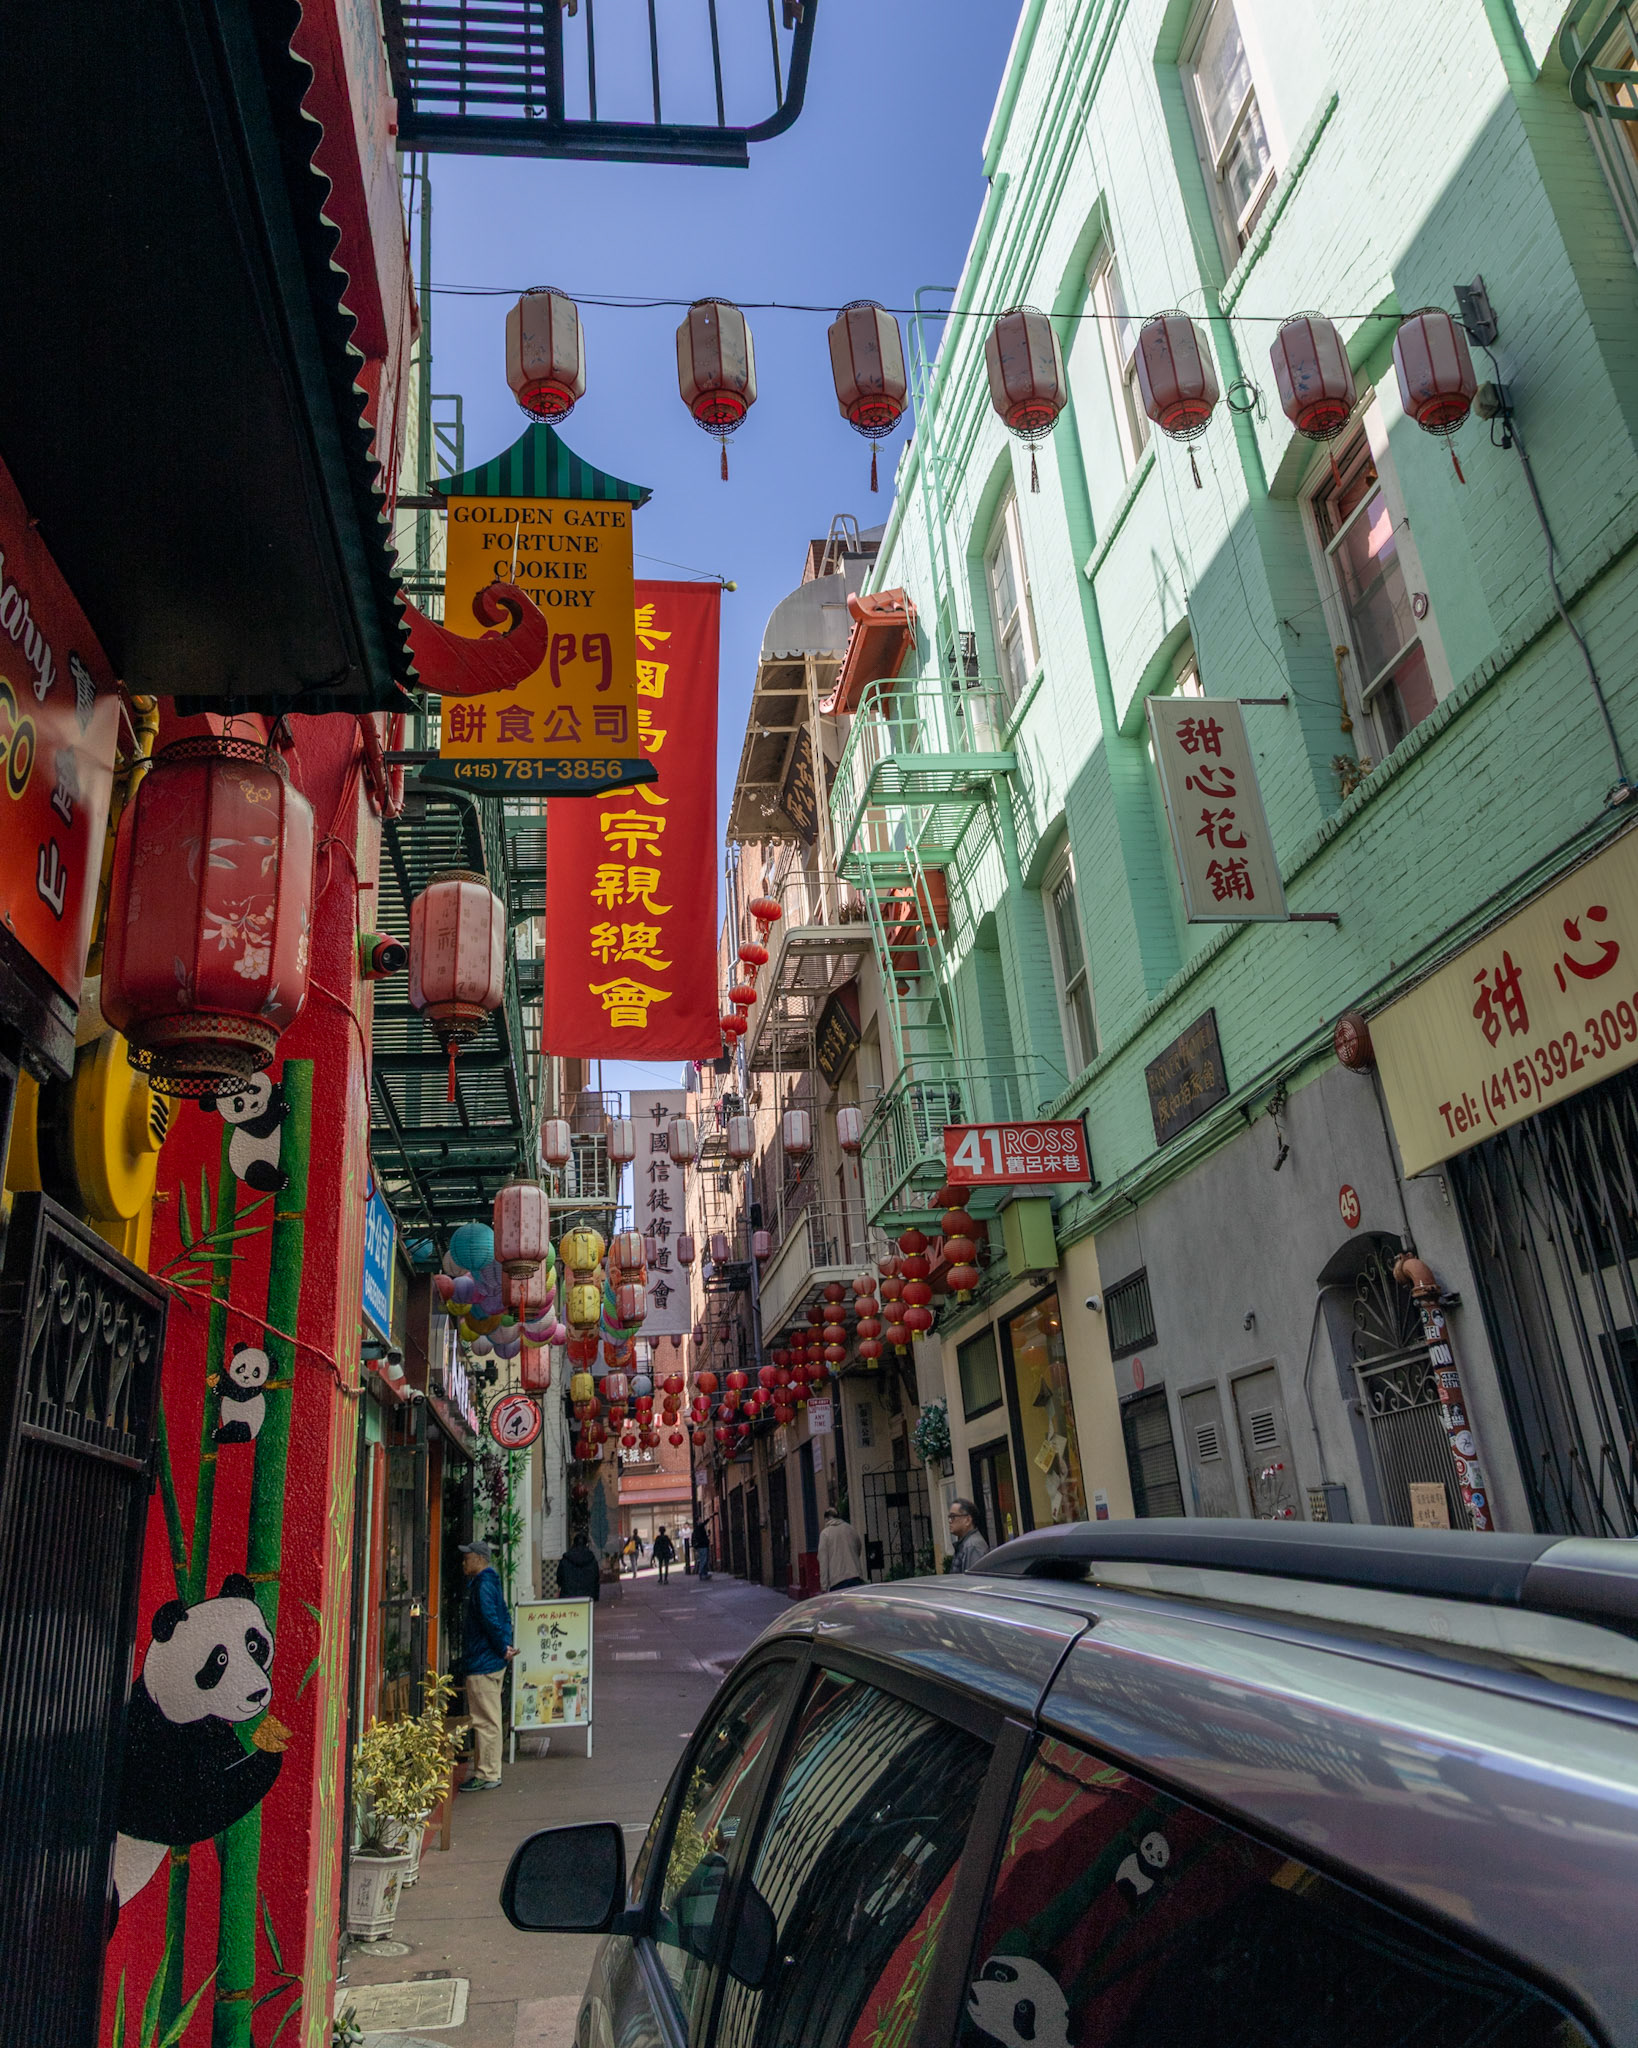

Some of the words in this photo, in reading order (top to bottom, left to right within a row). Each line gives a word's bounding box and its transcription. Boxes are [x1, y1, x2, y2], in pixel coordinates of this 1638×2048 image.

[454, 506, 554, 525] GOLDEN
[564, 510, 626, 528] GATE
[481, 533, 599, 554] FORTUNE
[493, 560, 587, 581] COOKIE
[523, 588, 596, 609] TORY
[0, 551, 57, 702] ary
[447, 703, 629, 745] 餅食公司
[454, 762, 498, 780] (415)
[502, 759, 623, 780] 781-3856
[1472, 904, 1621, 1049] 甜心
[1438, 1092, 1482, 1139] Tel:
[952, 1129, 1004, 1175] 41
[1003, 1127, 1078, 1155] ROSS
[1006, 1154, 1081, 1174] 舊呂宋巷
[1340, 1189, 1358, 1221] 45
